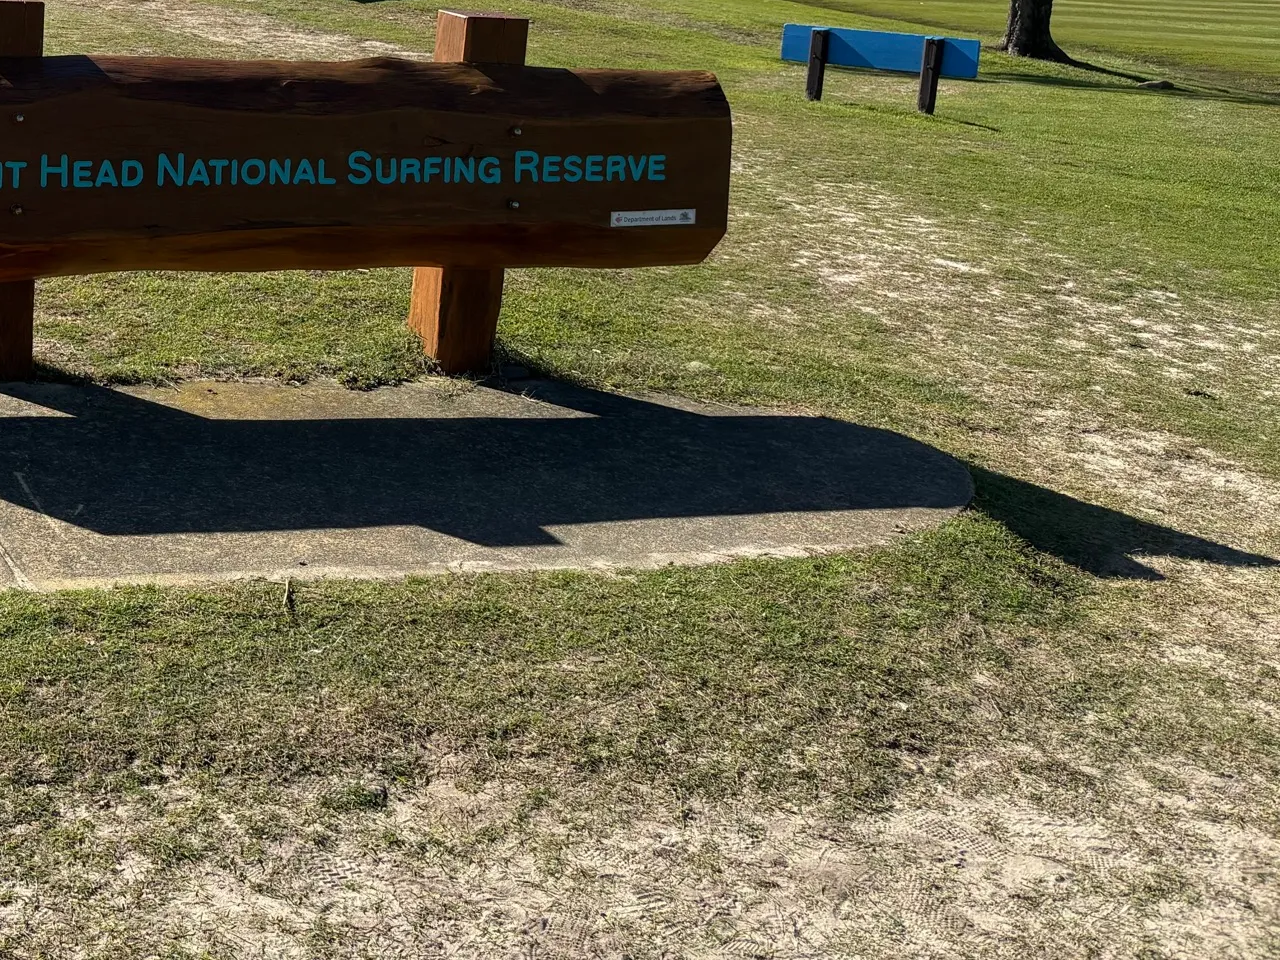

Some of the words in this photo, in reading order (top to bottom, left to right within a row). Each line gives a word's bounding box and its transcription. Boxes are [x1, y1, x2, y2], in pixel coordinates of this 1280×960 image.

[40, 153, 144, 189] HEAD
[156, 152, 336, 187] NATIONAL
[347, 150, 501, 185] SURFING
[513, 149, 667, 184] RESERVE
